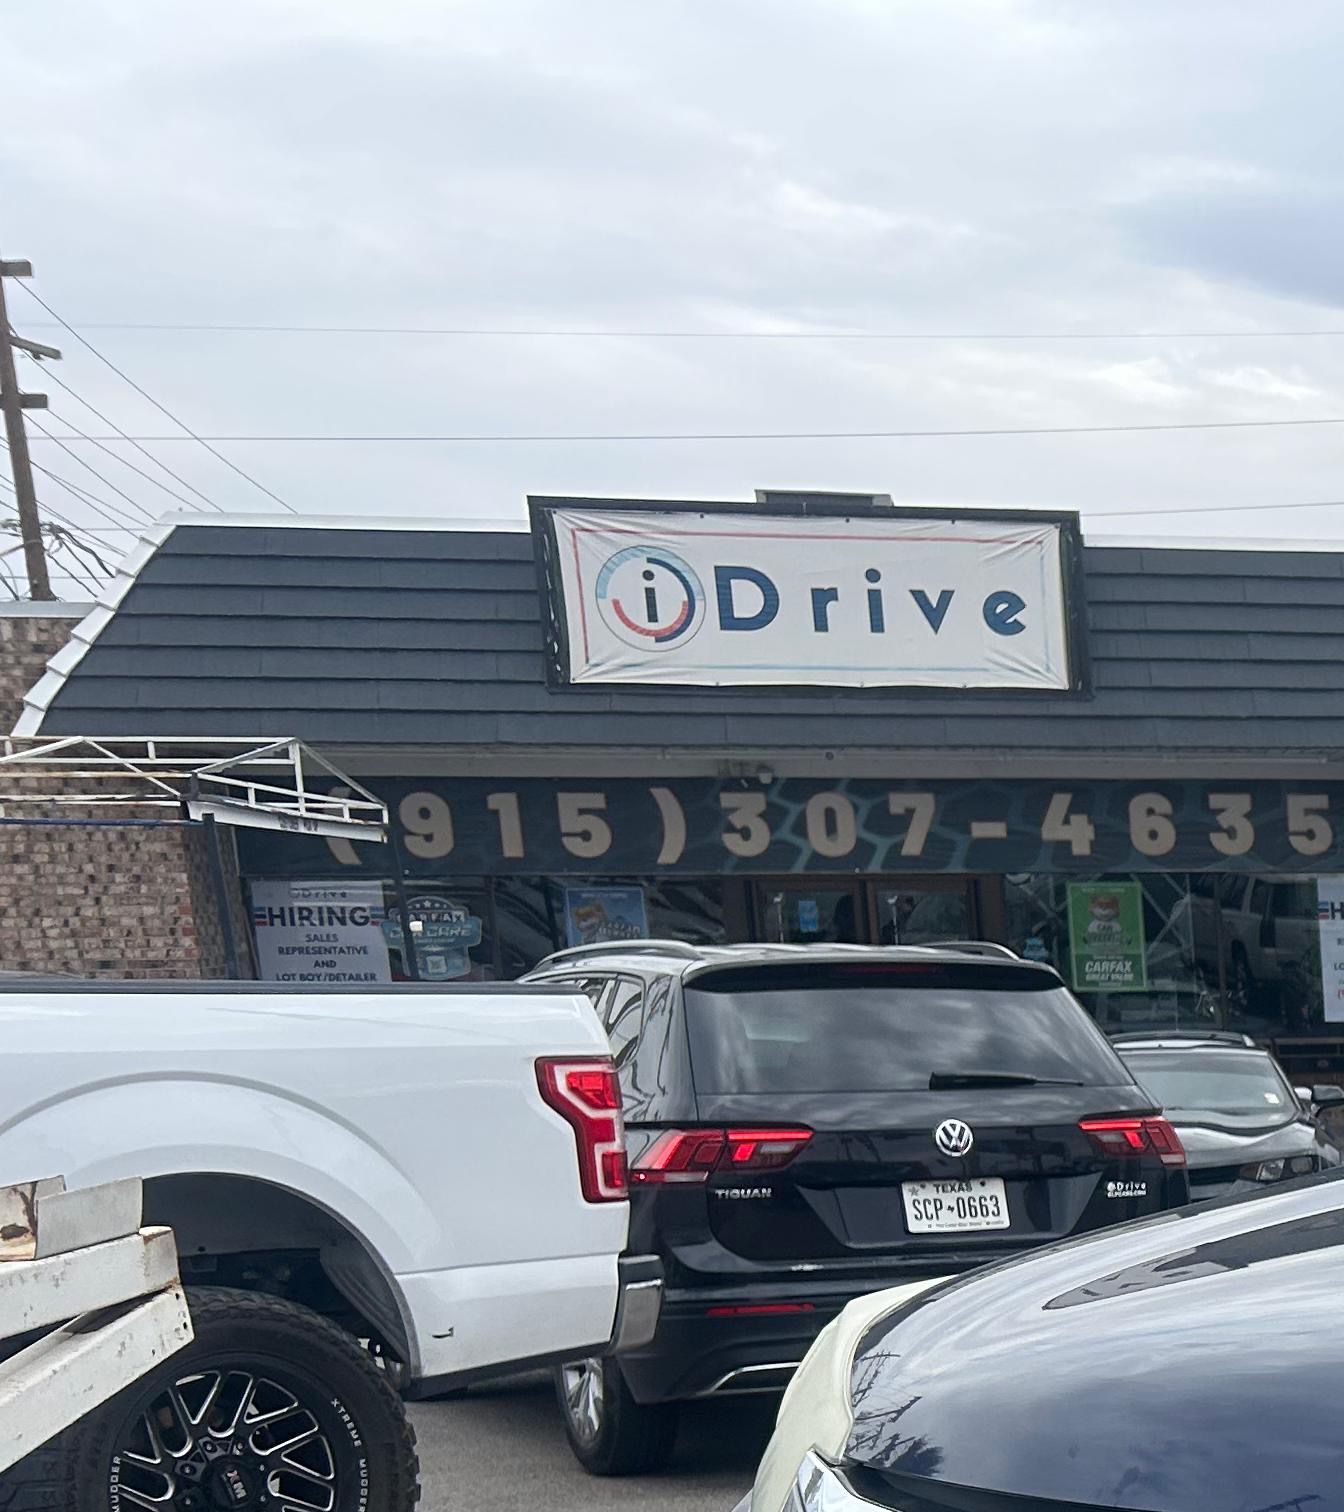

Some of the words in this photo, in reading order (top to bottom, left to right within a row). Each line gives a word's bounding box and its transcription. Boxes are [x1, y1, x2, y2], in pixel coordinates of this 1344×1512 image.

[268, 906, 370, 926] HIRING
[305, 932, 339, 943] SALES
[277, 945, 368, 956] REPRESENTATIVE
[313, 959, 337, 969] AND
[1084, 960, 1133, 973] CARFAX
[276, 972, 298, 982] LOT
[933, 1181, 973, 1193] TEXAS
[912, 1198, 944, 1220] SCP
[956, 1195, 1001, 1219] 0663
[331, 1398, 362, 1448] XTREME
